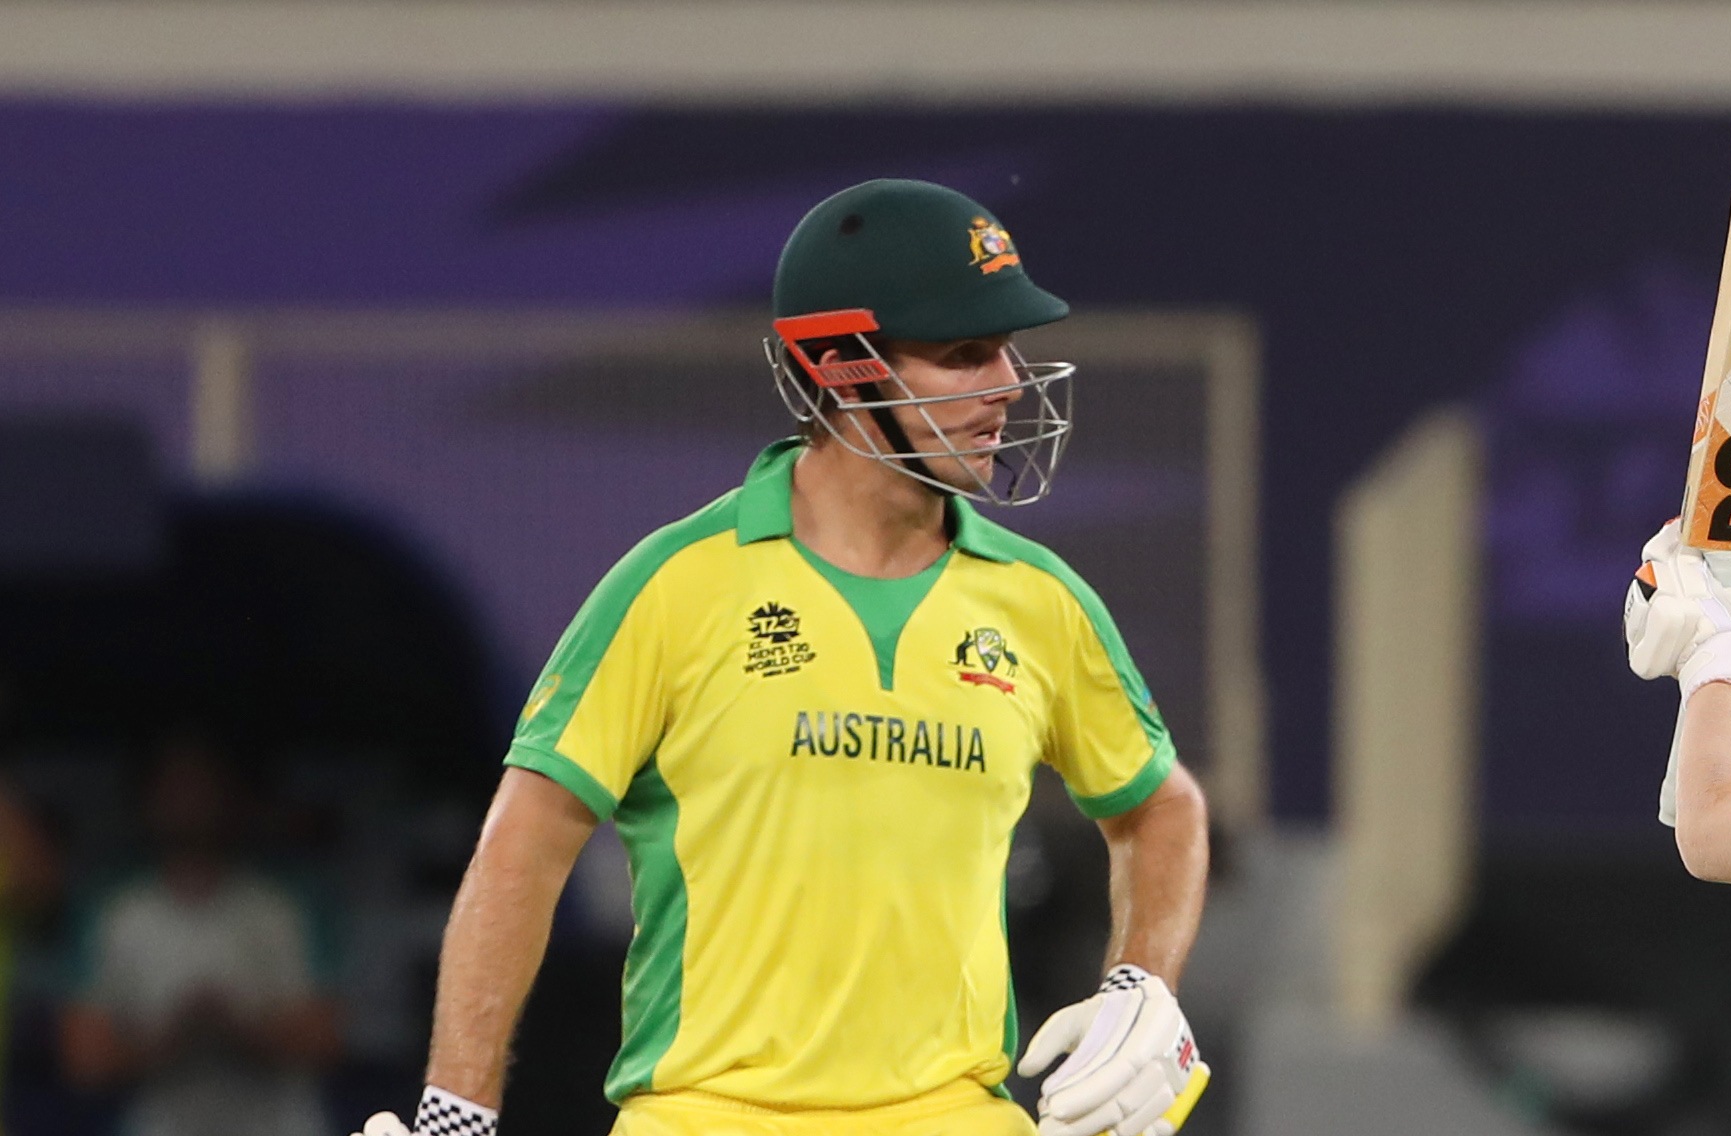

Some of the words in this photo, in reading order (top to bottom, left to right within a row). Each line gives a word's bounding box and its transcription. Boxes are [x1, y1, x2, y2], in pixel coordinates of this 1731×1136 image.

[744, 655, 790, 673] WORLD
[791, 651, 817, 664] CUP
[790, 711, 986, 773] AUSTRALIA
